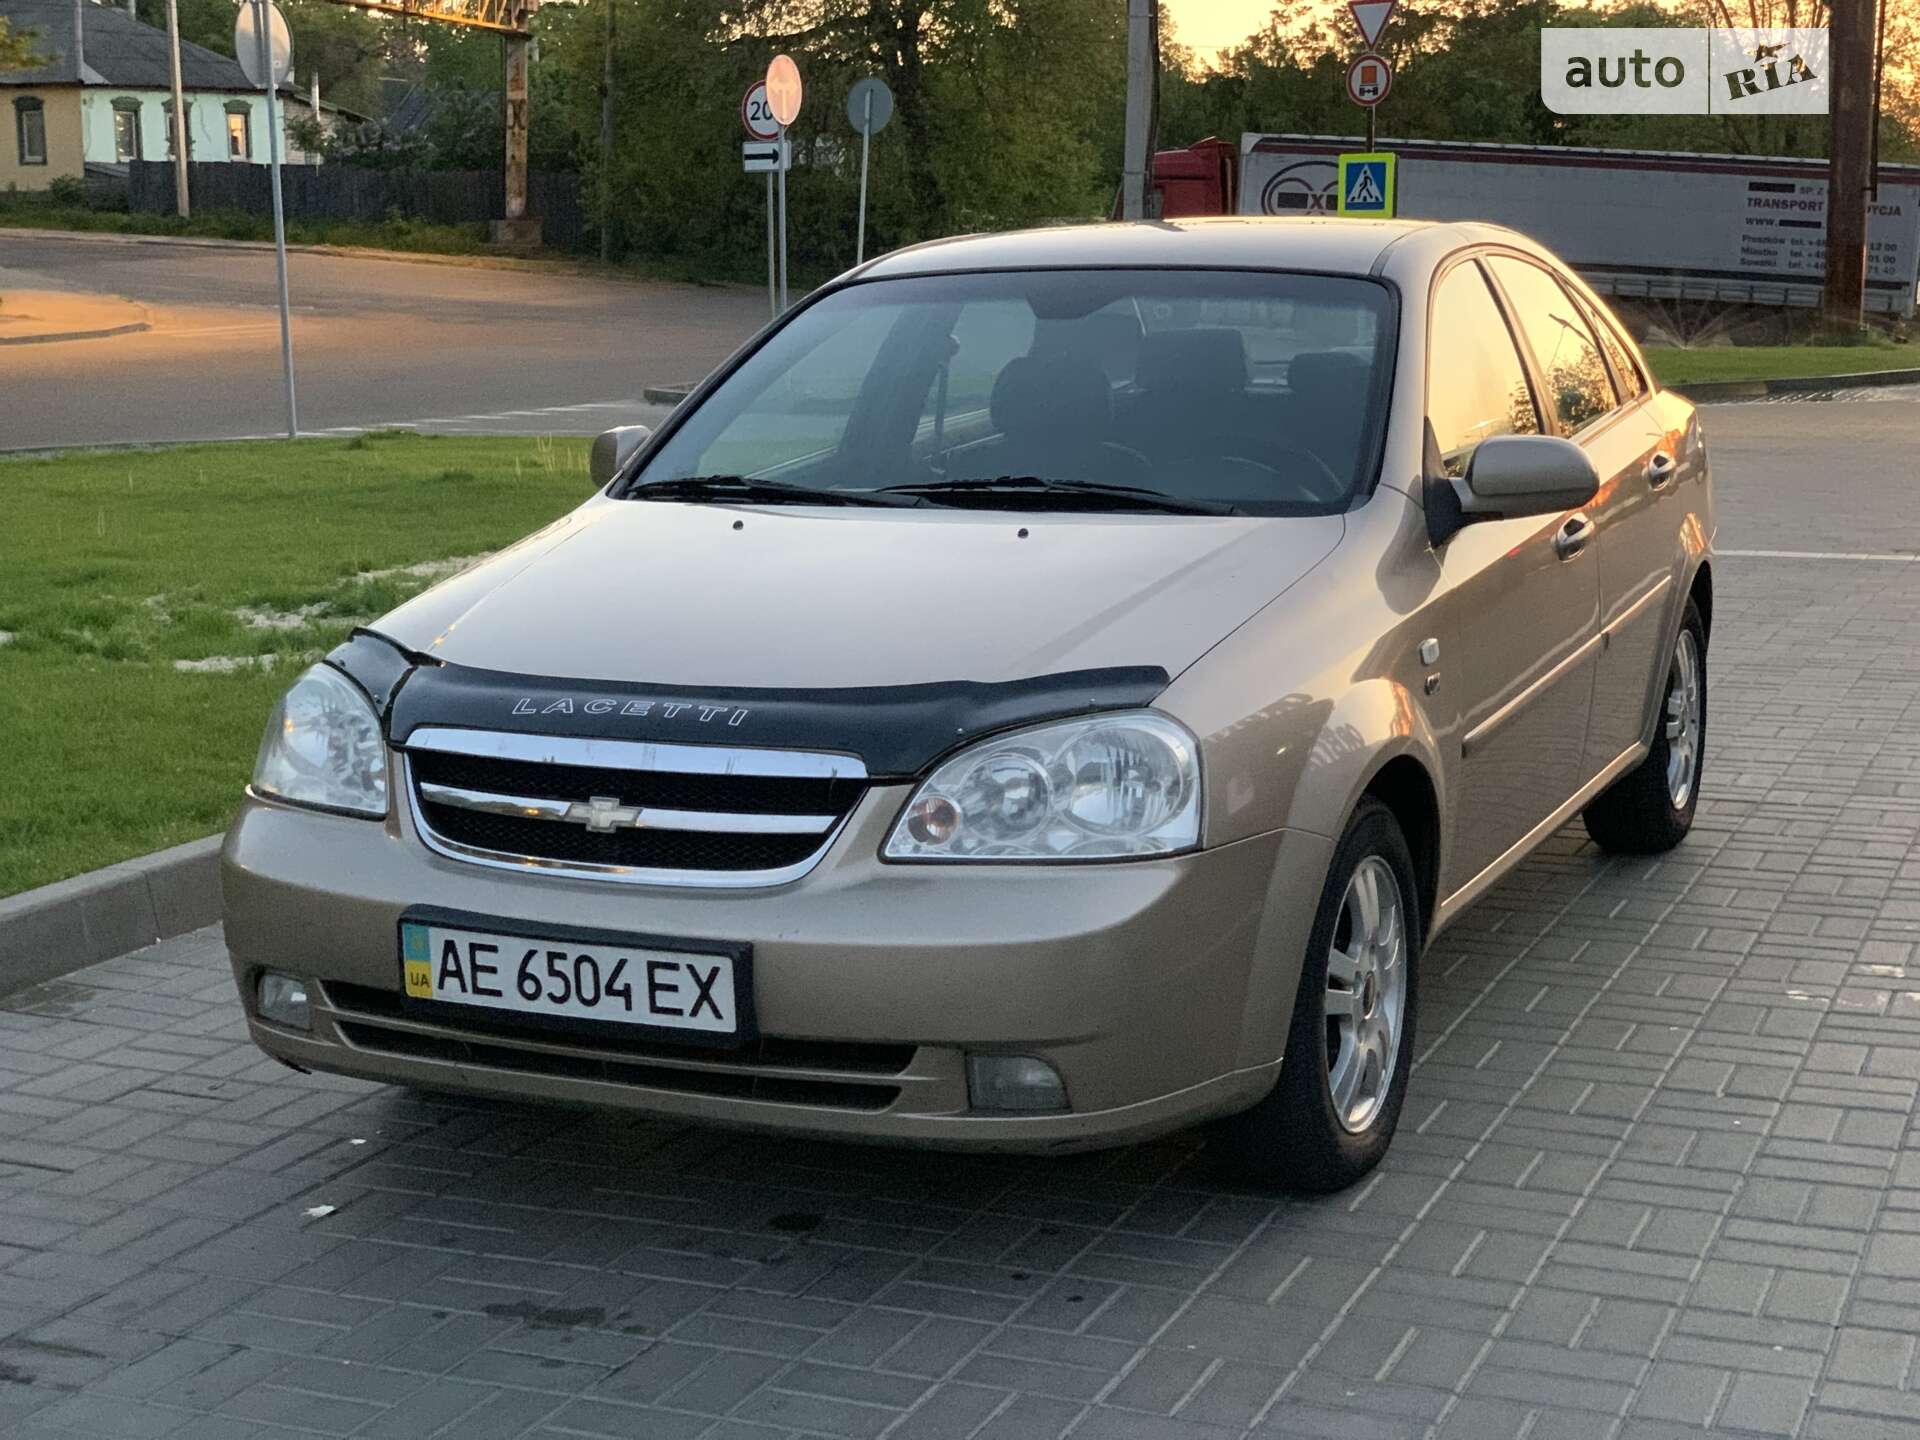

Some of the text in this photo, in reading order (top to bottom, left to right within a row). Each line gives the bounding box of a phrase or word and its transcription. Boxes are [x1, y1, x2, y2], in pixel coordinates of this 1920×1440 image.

[750, 101, 773, 121] 20
[1746, 197, 1824, 212] TRANSPORT
[511, 697, 750, 726] LACETTI
[409, 971, 430, 989] UA
[437, 939, 724, 1020] AE 6504 EX
